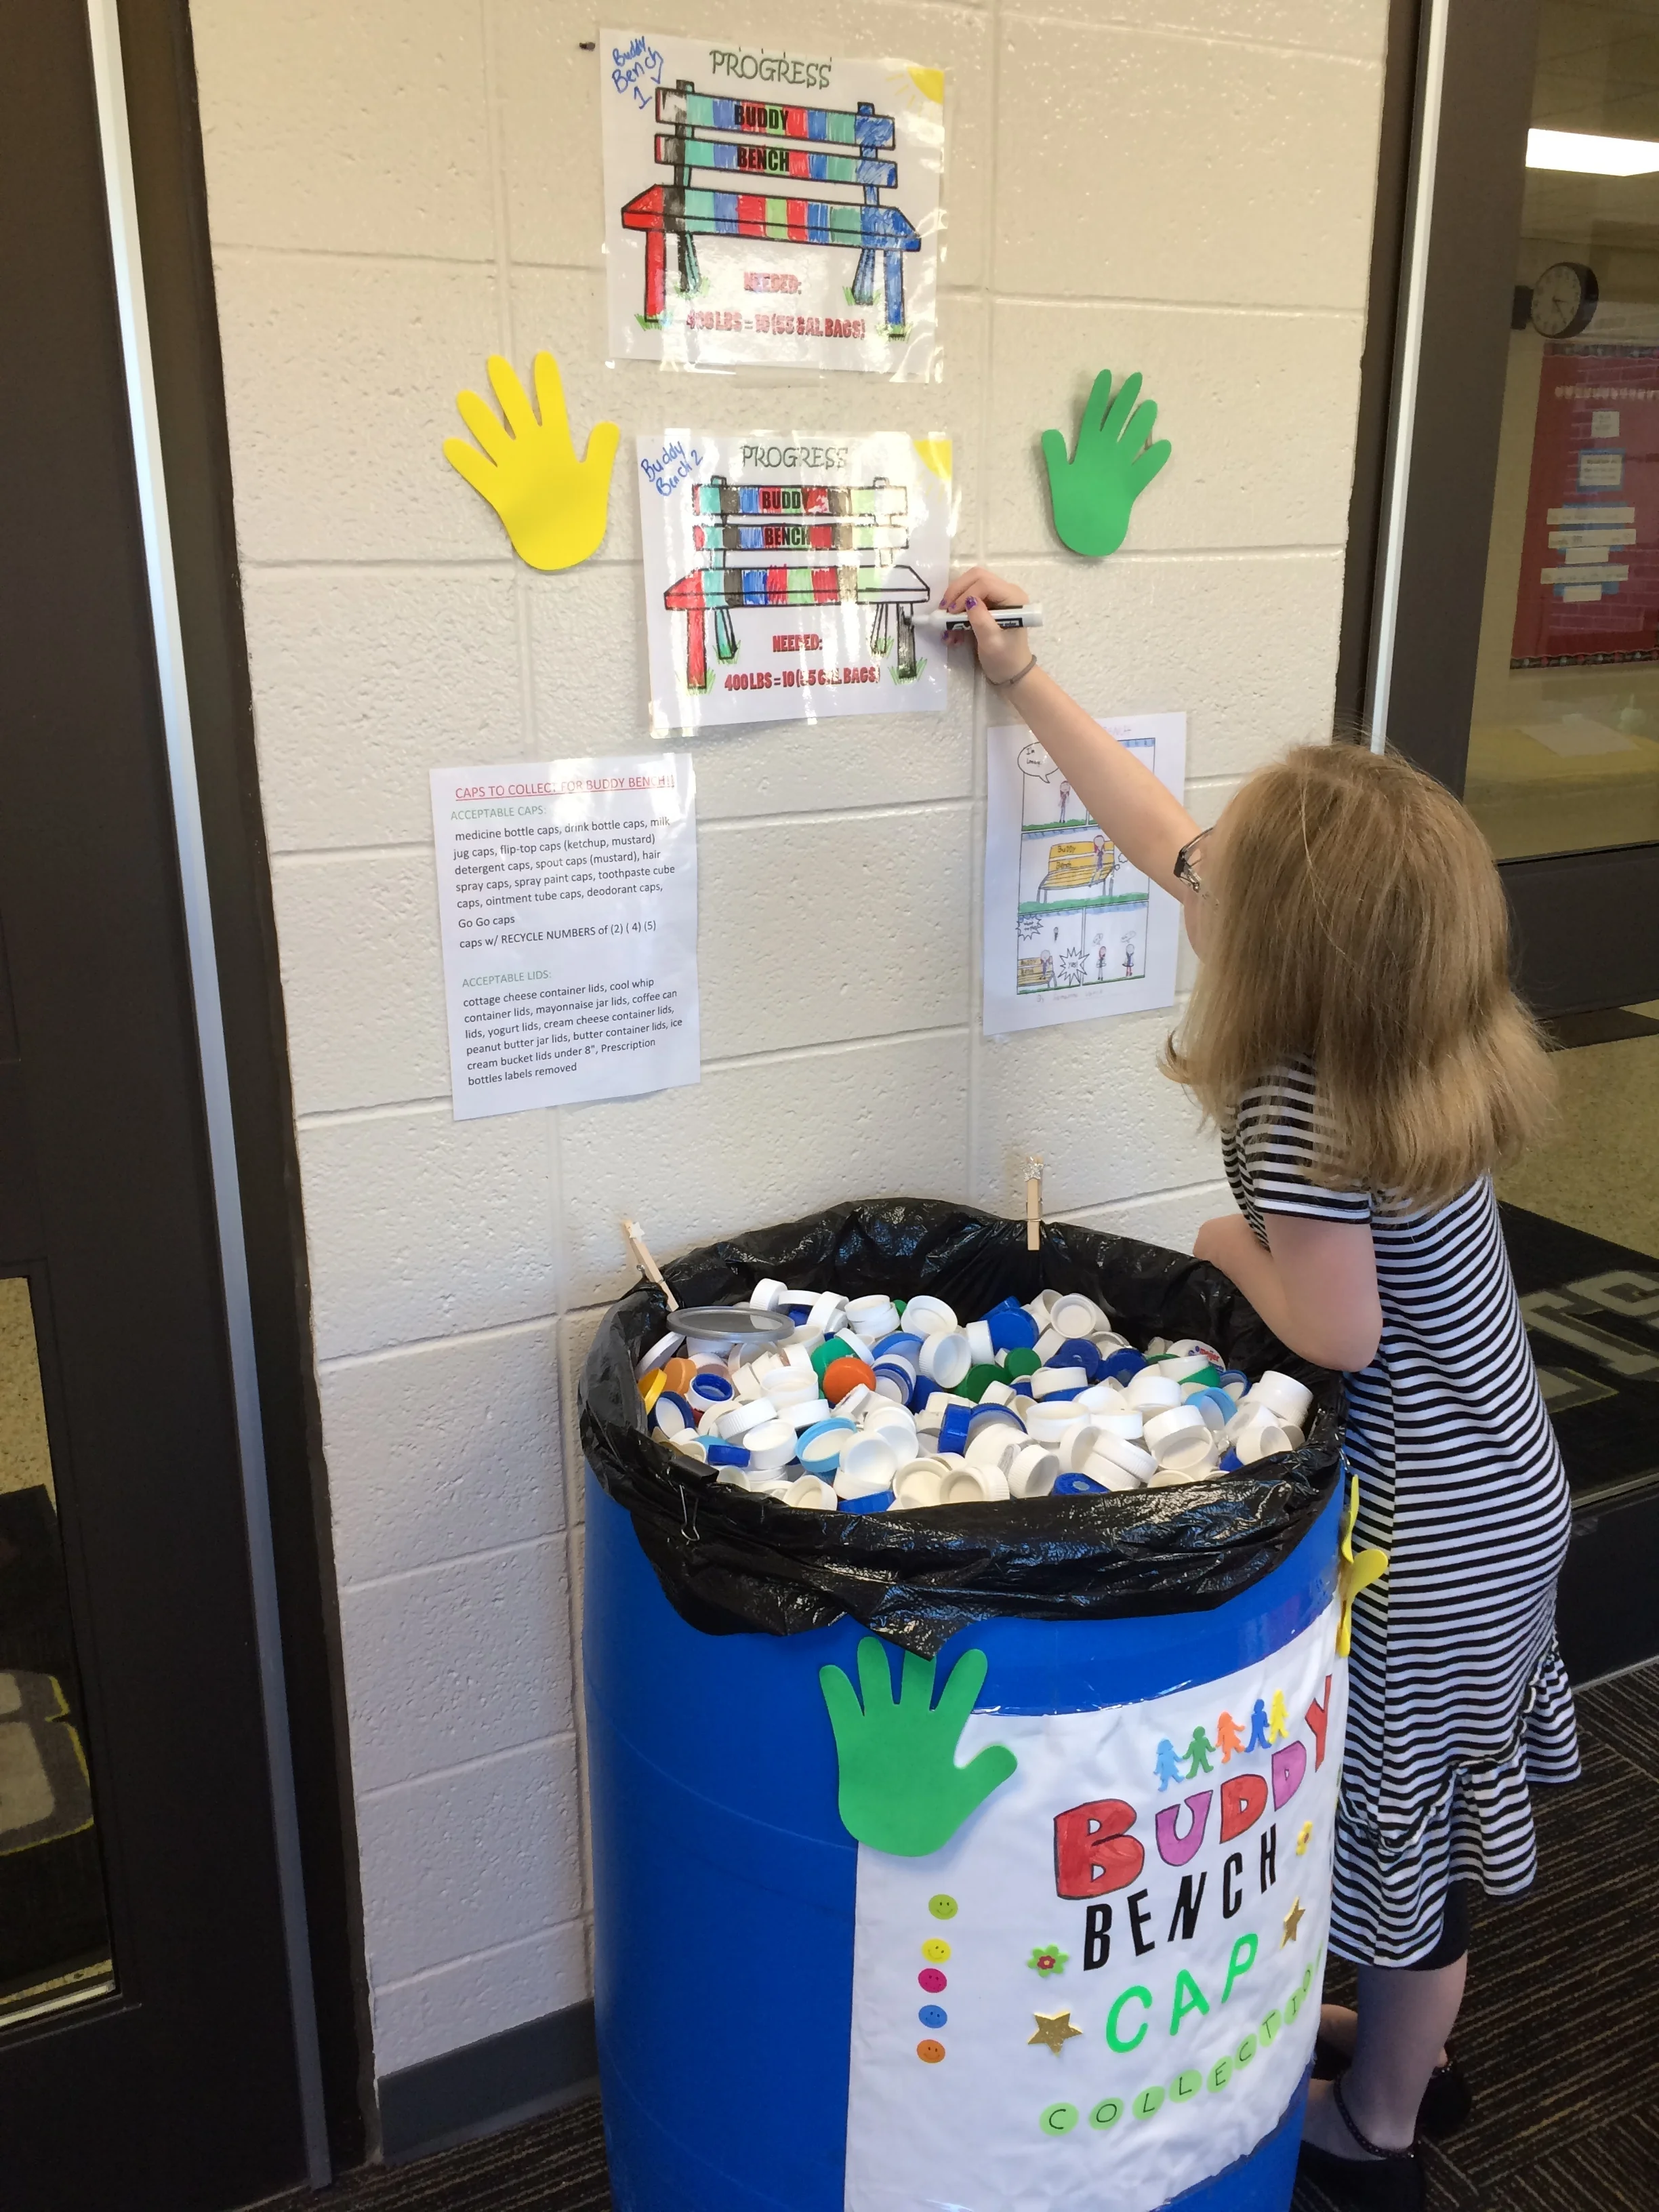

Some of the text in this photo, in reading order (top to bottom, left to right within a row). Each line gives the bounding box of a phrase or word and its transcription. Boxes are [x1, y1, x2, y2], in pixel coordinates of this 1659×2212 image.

[613, 35, 646, 67] Buddy
[612, 47, 659, 94] Bench
[710, 49, 832, 89] PROGRESS
[634, 86, 652, 109] 1
[735, 104, 789, 130] BUDDY
[737, 146, 790, 171] BENCH
[641, 441, 685, 483] Buddy
[741, 445, 848, 470] PROGRESS
[655, 449, 703, 497] Bench 2
[764, 527, 811, 546] BENCH
[773, 634, 823, 653] NEEDED:
[724, 674, 748, 691] 400
[750, 672, 772, 690] LBS
[774, 677, 781, 685] =
[783, 670, 795, 688] 10
[818, 668, 842, 685] GL
[455, 785, 485, 799] CAPS
[489, 785, 505, 797] TO
[586, 777, 625, 791] BUDDY
[451, 805, 547, 821] ACCEPTABLE CAPS:
[455, 816, 670, 842] medicine bottle caps, drink bottle caps, milk
[453, 834, 655, 861] jug caps, flip-top caps (ketchup, mustard)
[455, 851, 661, 876] detergent caps, spout caps (mustard), hair
[455, 865, 675, 893] spray caps, spray paint caps, toothpaste cube
[457, 883, 663, 909] caps, ointment tube caps, deodorant caps,
[458, 916, 515, 928] Go Go caps
[459, 939, 483, 949] caps
[485, 935, 498, 946] w/
[501, 931, 544, 944] RECYCLE
[546, 927, 596, 940] NUMBERS
[598, 924, 609, 935] of
[610, 923, 623, 935] (2)
[644, 920, 656, 931] (5)
[462, 970, 552, 988] ACCEPTABLE LIDS:
[463, 978, 655, 1008] cottage cheese container lids, cool whip
[464, 990, 677, 1023] container lids, mayonnaise jar lids, coffee can
[465, 1004, 674, 1040] lids, yogurt lids, cream cheese container lids,
[466, 1018, 682, 1057] peanut butter jar lids, butter container lids, ice
[467, 1060, 498, 1071] cream
[500, 1054, 534, 1066] bucket
[535, 1050, 552, 1062] lids
[554, 1047, 583, 1060] under
[600, 1038, 656, 1052] Prescription
[468, 1062, 577, 1086] bottles labels removed
[1053, 1674, 1332, 1900] BUDDY
[1084, 1824, 1277, 1971] BENCH
[1105, 1933, 1259, 2053] CAP
